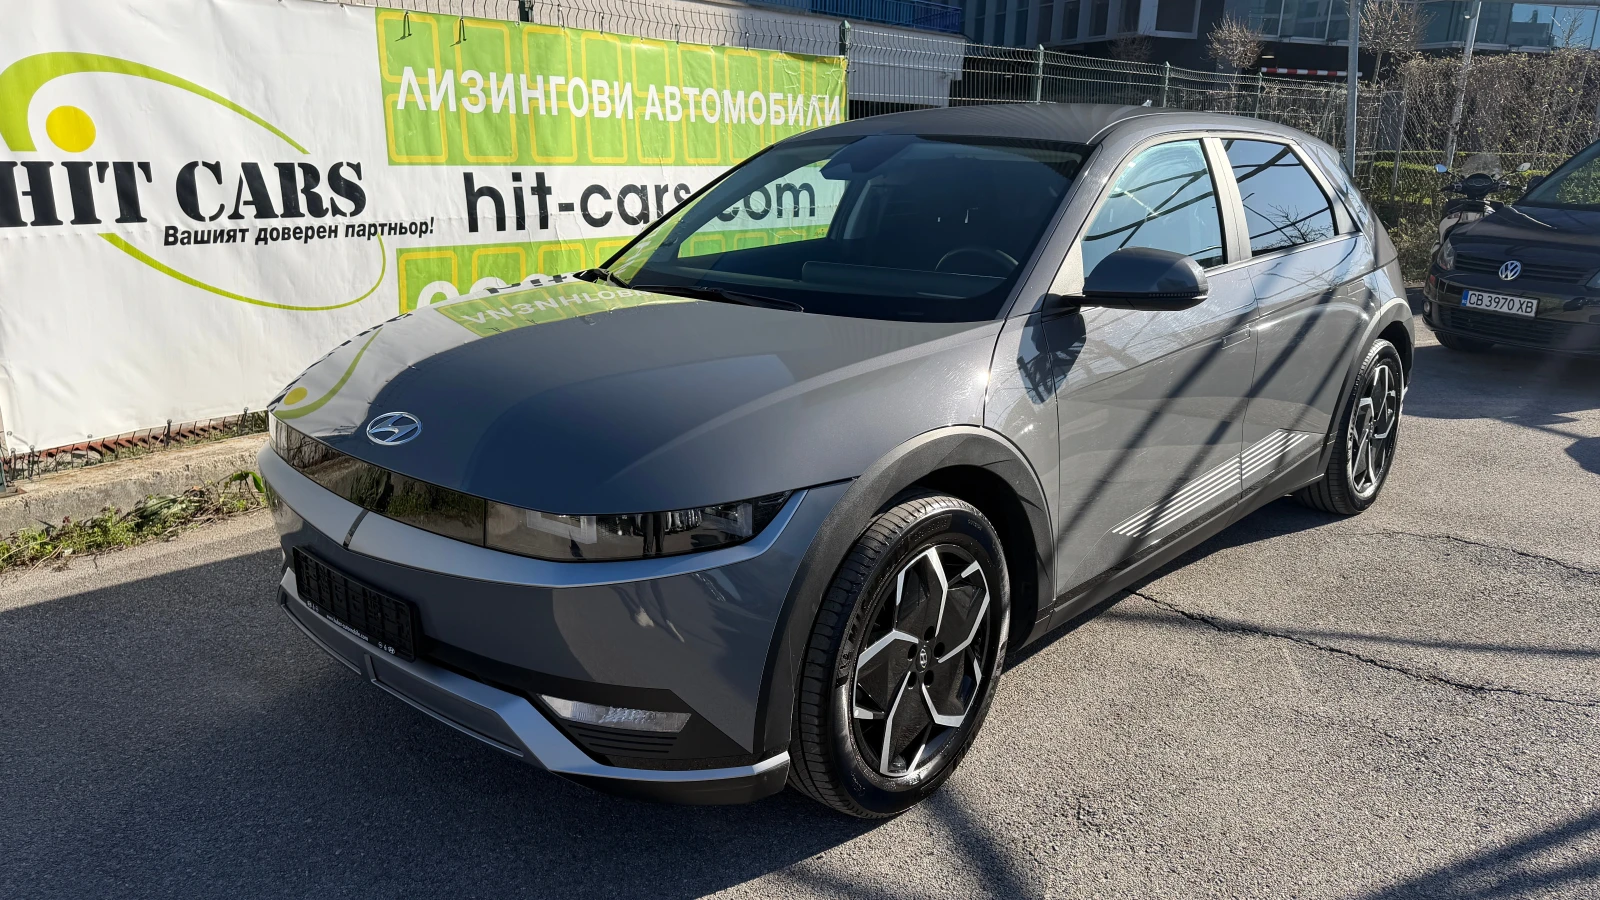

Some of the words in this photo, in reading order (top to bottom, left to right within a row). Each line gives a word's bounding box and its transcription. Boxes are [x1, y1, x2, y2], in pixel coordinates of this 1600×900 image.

[396, 66, 634, 119] ЛИЗИНГОВИ
[644, 83, 841, 127] АВТОМОБИЛИ
[0, 160, 153, 228] HIT
[175, 160, 367, 222] CARS
[163, 225, 249, 246] Вашият
[254, 223, 338, 246] доверен
[344, 217, 435, 242] партньор!
[1468, 293, 1484, 306] CB
[1486, 296, 1515, 311] 3970
[1516, 299, 1534, 314] XB
